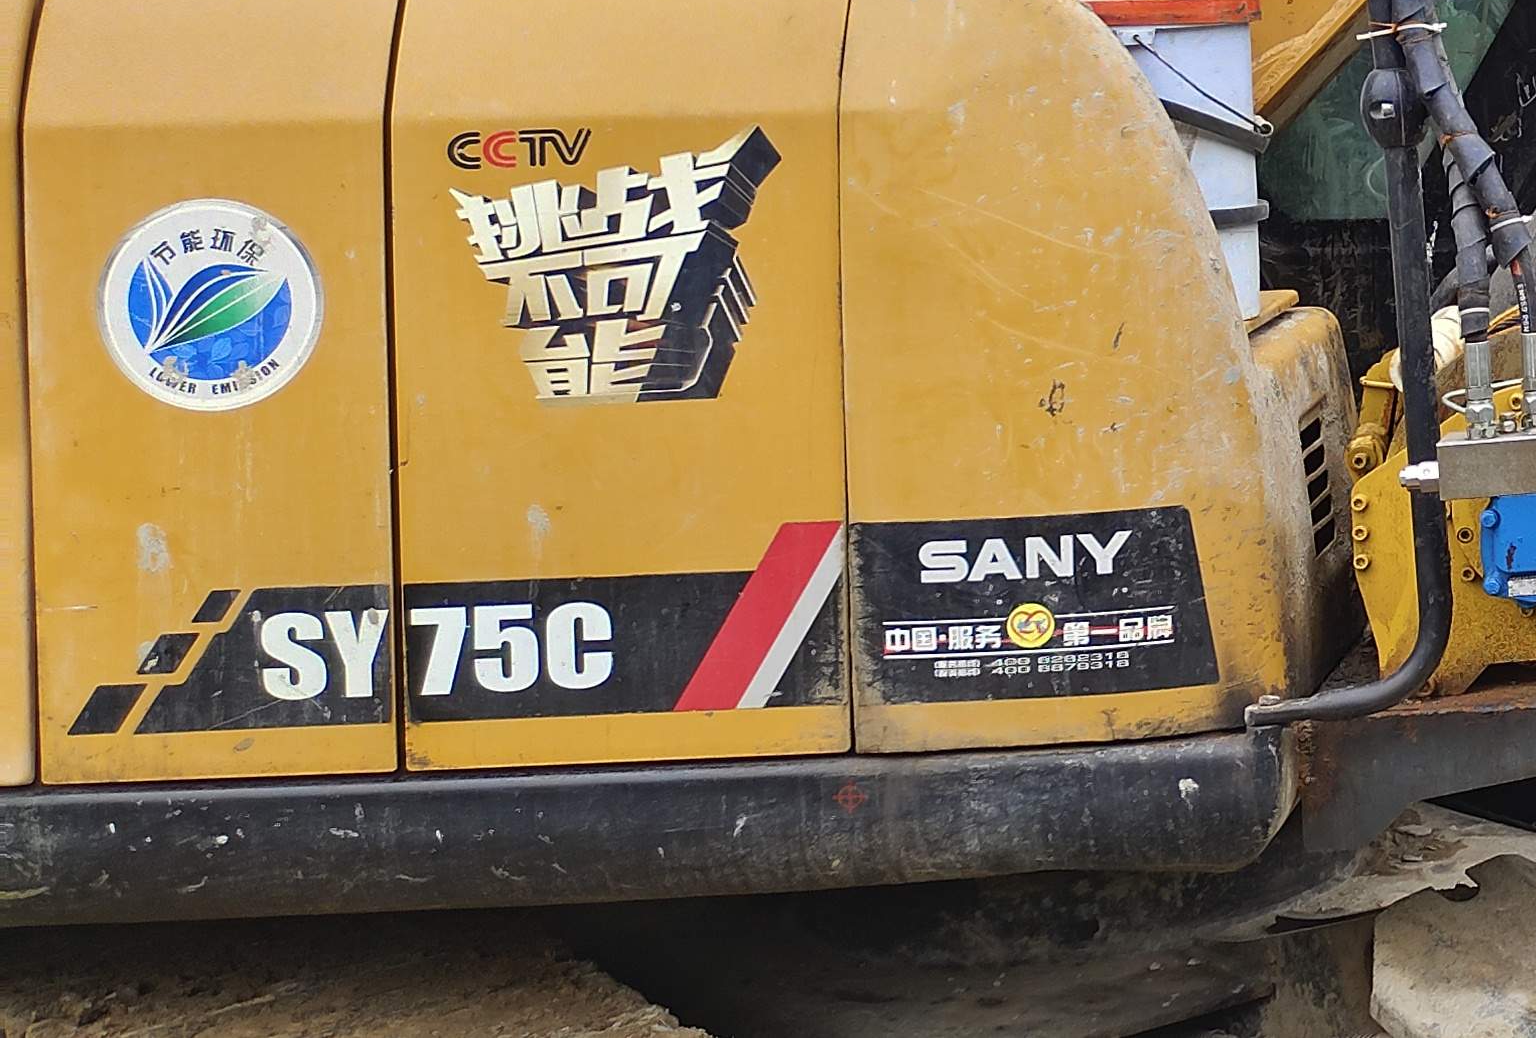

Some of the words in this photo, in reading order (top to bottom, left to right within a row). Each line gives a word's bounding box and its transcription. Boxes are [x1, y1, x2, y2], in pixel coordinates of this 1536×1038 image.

[447, 128, 592, 170] CCTV
[449, 126, 766, 263] 挑战
[150, 227, 266, 266] 节能环保
[477, 229, 708, 329] 不可
[211, 359, 280, 395] EMISION
[519, 318, 667, 403] 能
[918, 529, 1133, 584] SANY
